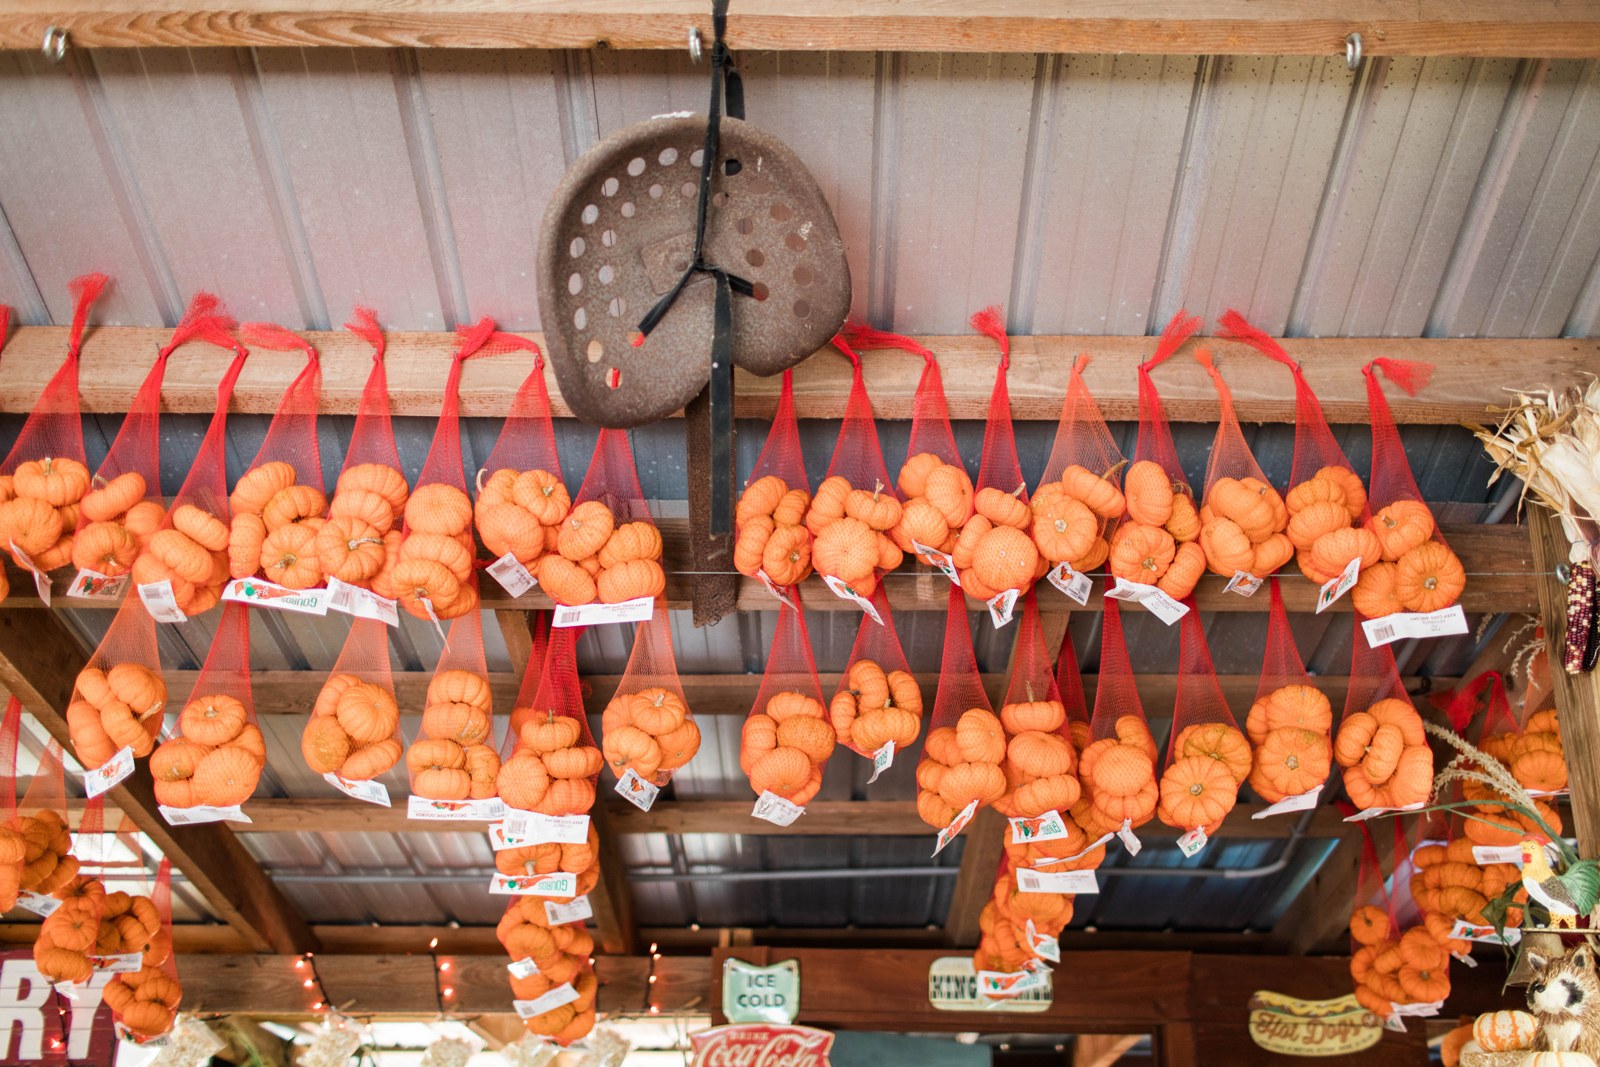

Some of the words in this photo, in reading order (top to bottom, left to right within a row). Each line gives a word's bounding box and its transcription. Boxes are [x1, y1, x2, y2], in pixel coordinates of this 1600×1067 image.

[281, 597, 318, 608] GOURDS
[538, 879, 568, 892] GOURDS
[747, 974, 777, 988] ICE
[736, 993, 786, 1008] COLD
[1255, 1012, 1300, 1042] Hot
[1301, 1019, 1361, 1046] Dogs
[728, 1032, 770, 1040] DRINK
